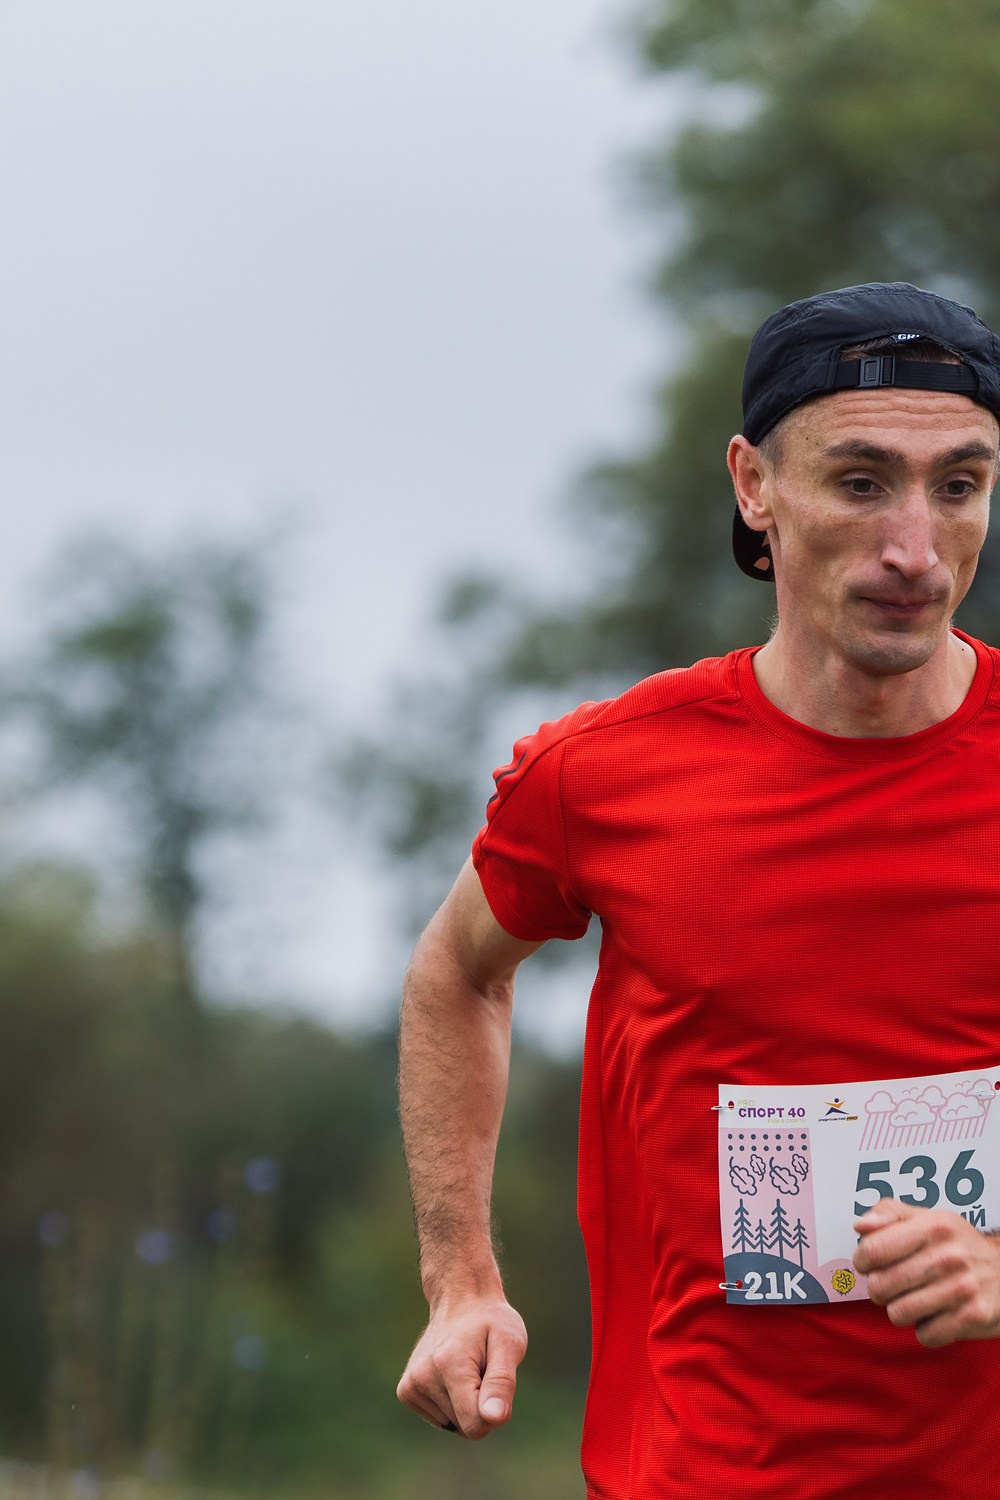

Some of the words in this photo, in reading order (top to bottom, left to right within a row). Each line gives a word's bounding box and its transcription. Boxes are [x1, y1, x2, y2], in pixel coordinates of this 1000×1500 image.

[738, 1107, 785, 1118] СПОРТ
[787, 1107, 806, 1118] 40
[854, 1149, 985, 1218] 536
[744, 1271, 807, 1300] 21K
